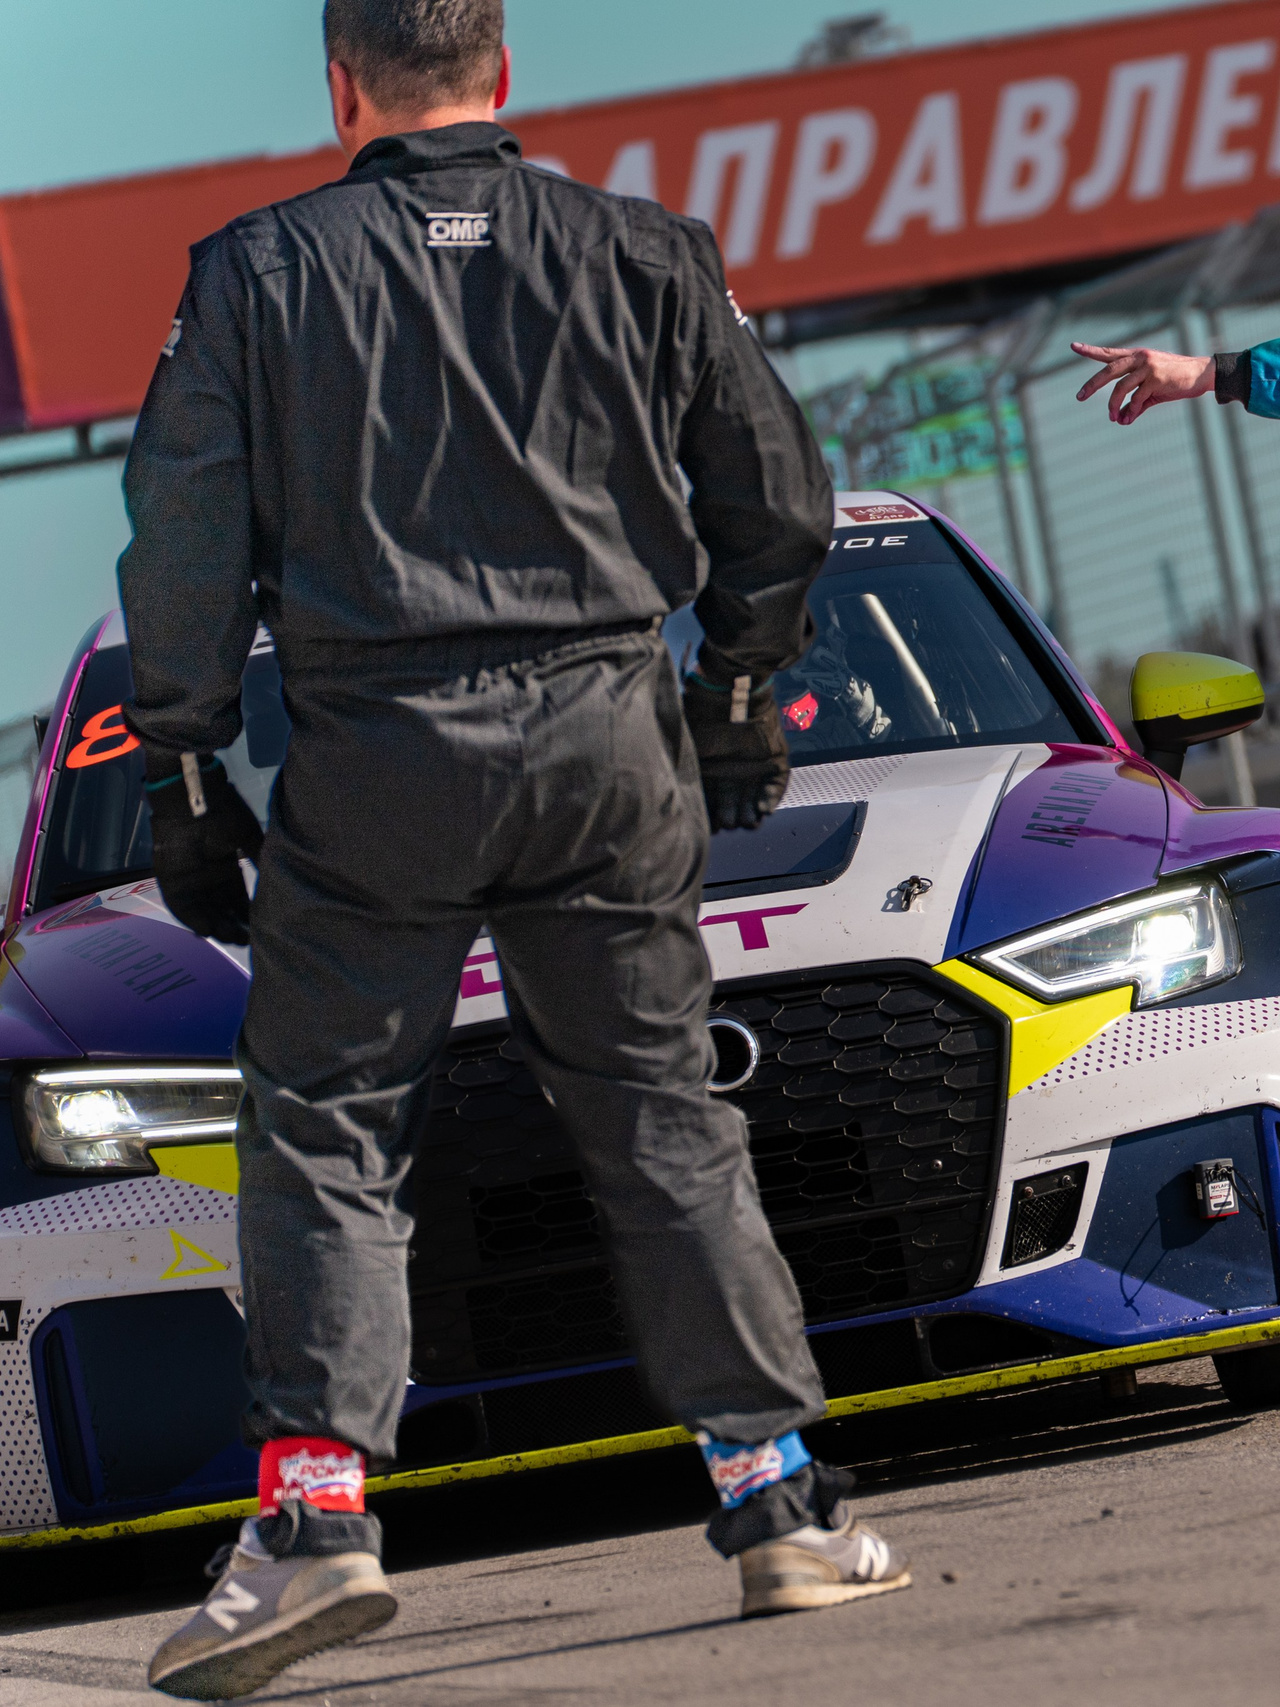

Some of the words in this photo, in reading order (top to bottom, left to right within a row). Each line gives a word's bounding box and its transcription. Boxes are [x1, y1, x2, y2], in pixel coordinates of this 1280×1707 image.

[427, 217, 489, 241] OMP
[1020, 795, 1098, 849] ARENA
[113, 951, 198, 1003] PLAY
